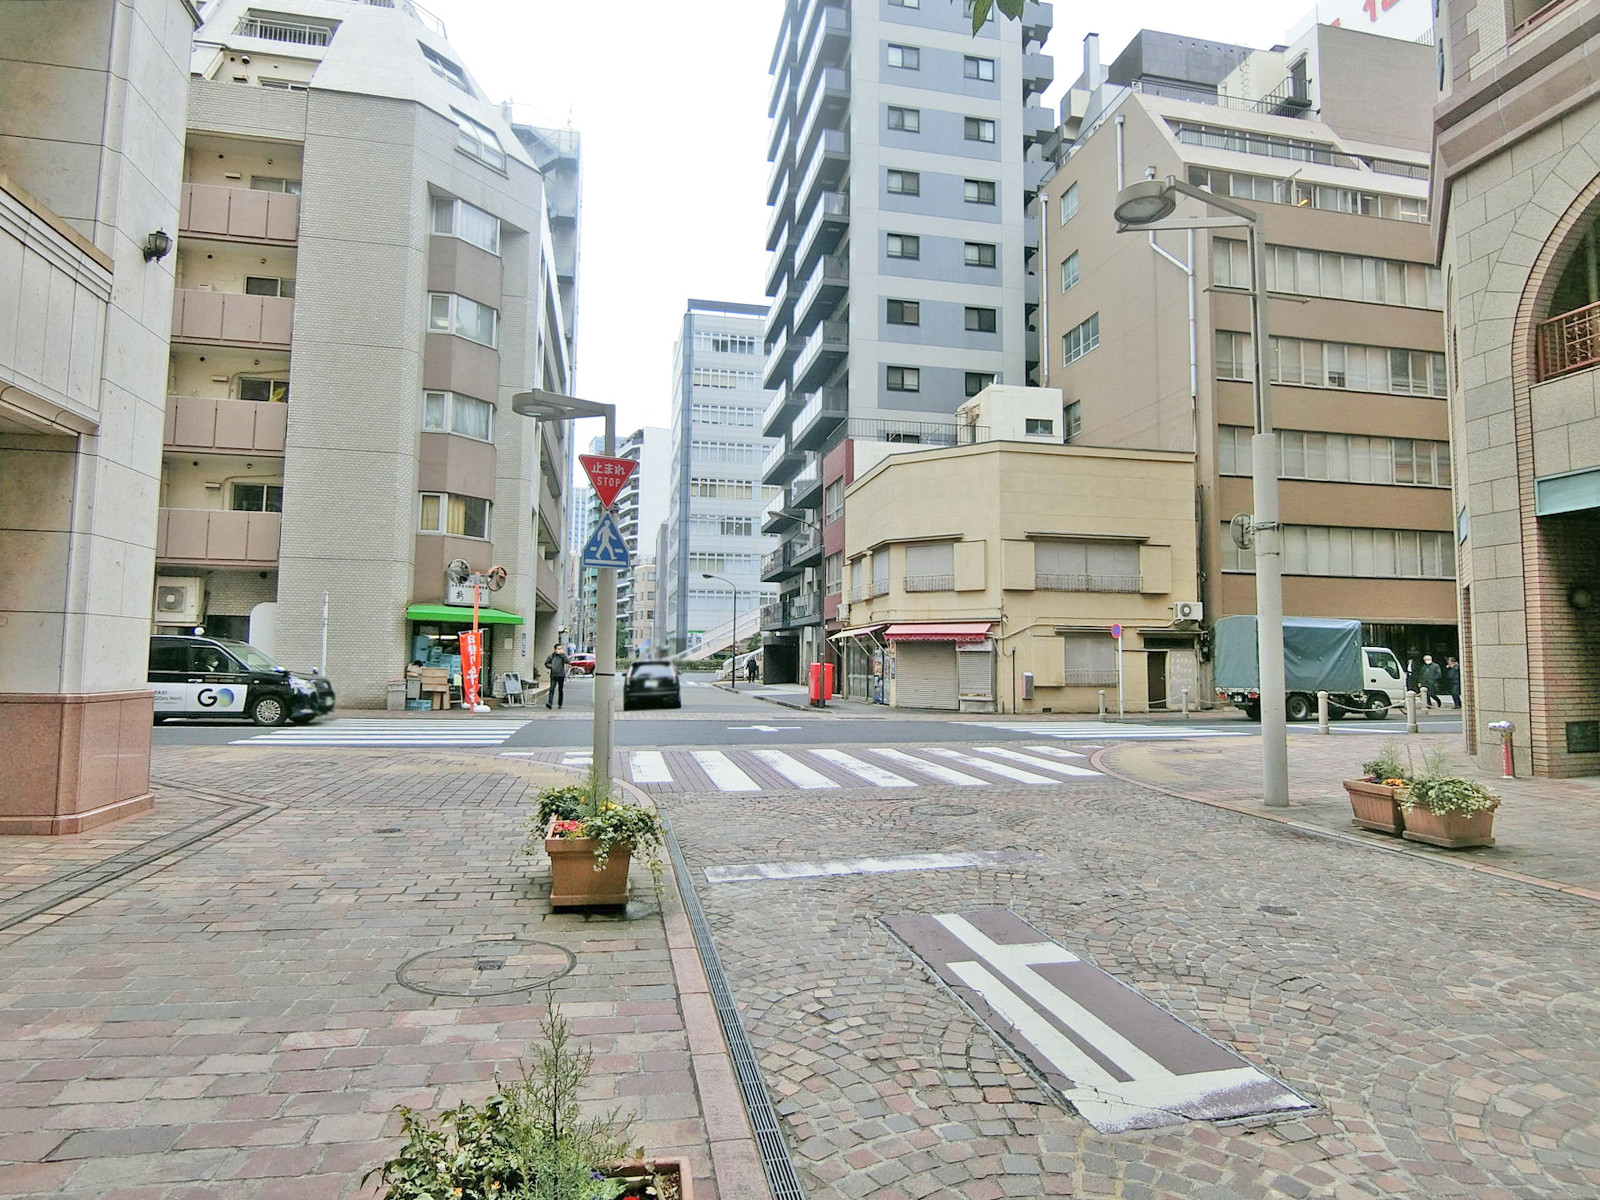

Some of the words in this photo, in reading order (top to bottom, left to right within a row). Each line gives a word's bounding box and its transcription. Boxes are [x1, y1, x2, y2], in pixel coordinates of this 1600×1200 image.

[591, 461, 626, 475] 止まれ
[597, 476, 620, 487] STOP
[197, 688, 234, 707] GO
